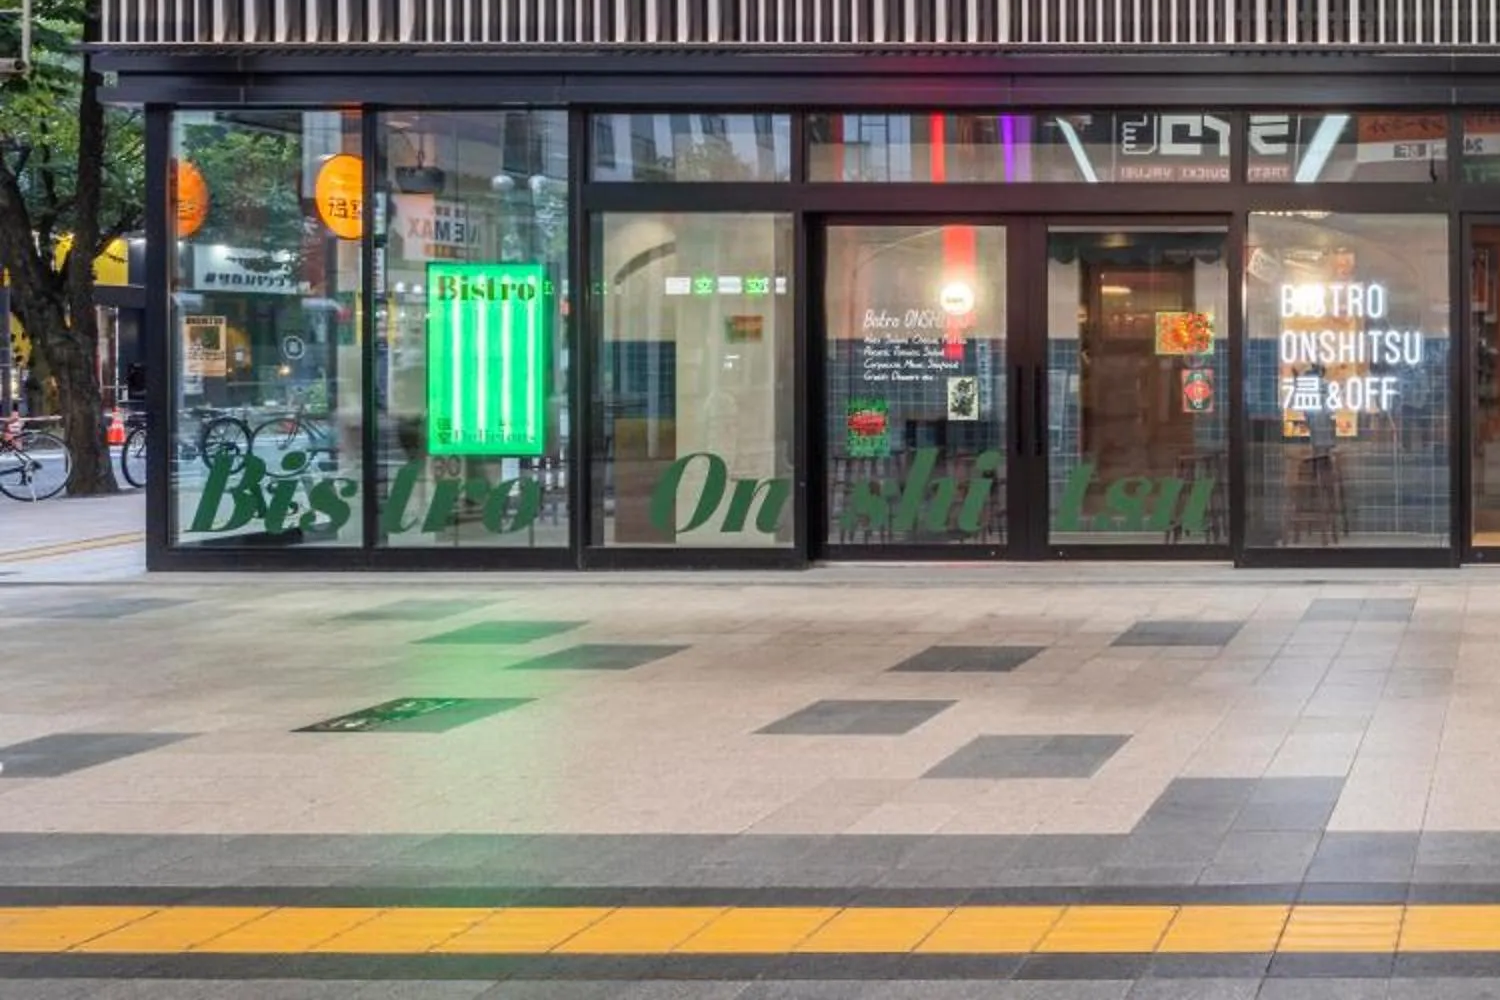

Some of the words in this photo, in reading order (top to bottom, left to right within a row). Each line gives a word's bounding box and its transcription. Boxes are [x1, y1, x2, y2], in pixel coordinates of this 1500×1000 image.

[436, 275, 536, 302] Bistro
[1281, 283, 1384, 318] BSTRO
[1281, 331, 1422, 365] ONSHITSU
